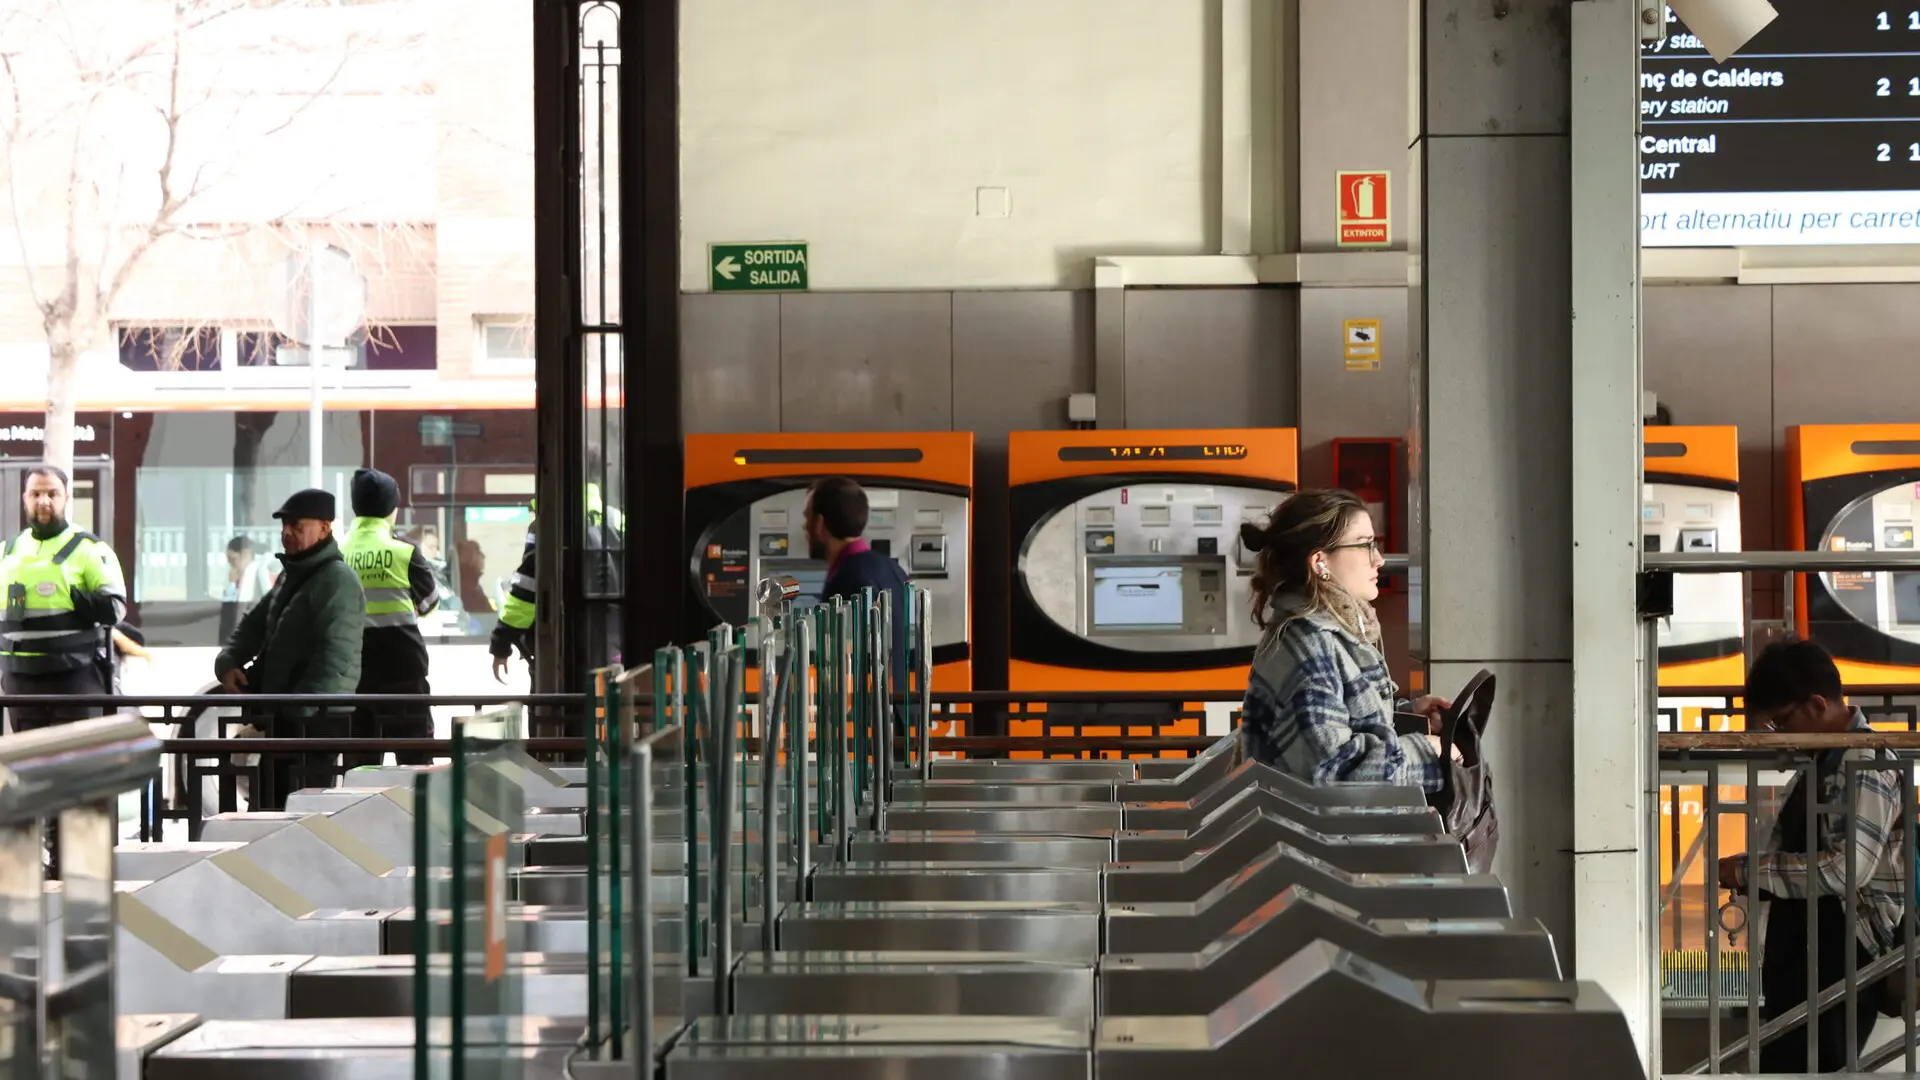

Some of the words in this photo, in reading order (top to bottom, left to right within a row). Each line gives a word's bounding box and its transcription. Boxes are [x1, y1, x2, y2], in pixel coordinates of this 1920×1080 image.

[1665, 5, 1677, 23] t.
[1877, 11, 1891, 30] 1
[1908, 11, 1920, 30] 1
[1641, 73, 1665, 92] nç
[1671, 69, 1697, 87] de
[1702, 67, 1784, 87] Calders
[1876, 77, 1891, 96] 2
[1908, 77, 1920, 96] 1
[1641, 99, 1667, 117] ery
[1670, 96, 1729, 114] station
[1641, 134, 1716, 153] Central
[1876, 142, 1891, 162] 2
[1908, 142, 1920, 161] 1
[1641, 162, 1680, 180] URT
[1641, 210, 1668, 230] ort
[1676, 208, 1792, 230] alternatiu
[1799, 211, 1842, 234] per
[1849, 208, 1920, 229] carret
[1343, 228, 1385, 238] EXTINTOR
[743, 249, 806, 265] SORTIDA
[749, 269, 801, 285] SALIDA
[345, 549, 393, 570] URIDAD
